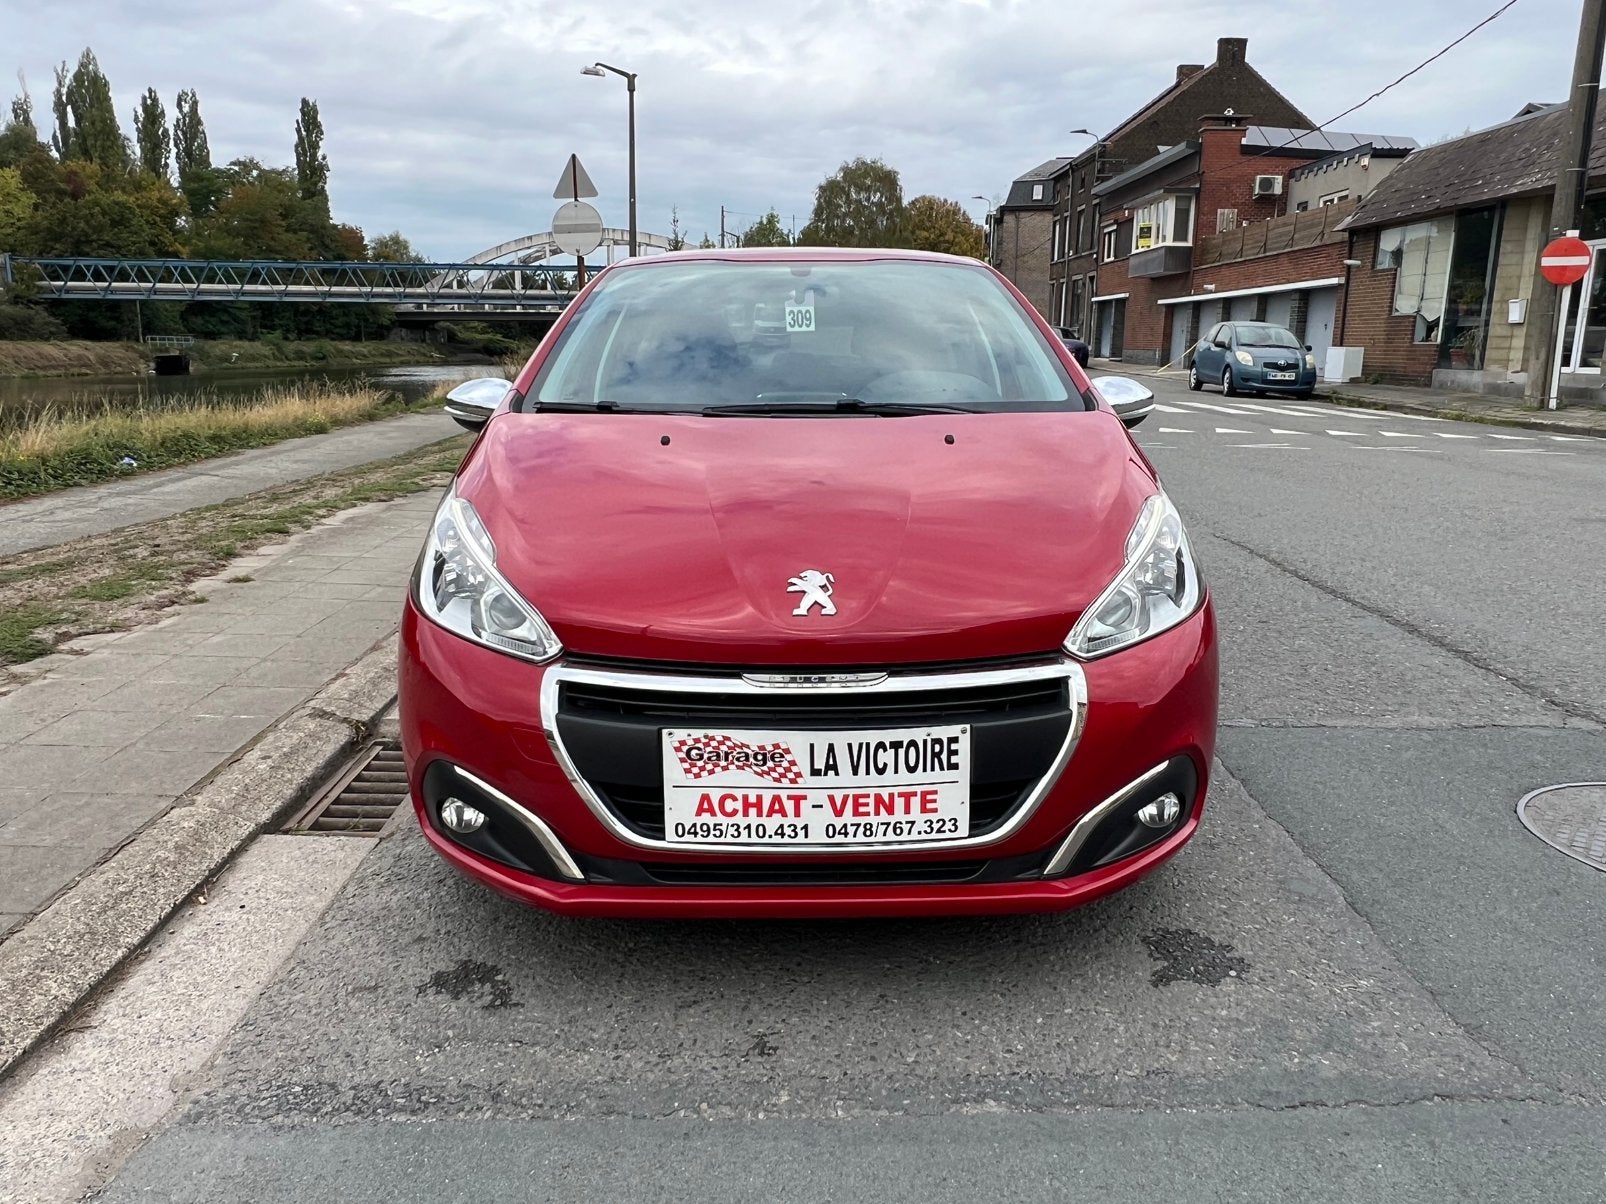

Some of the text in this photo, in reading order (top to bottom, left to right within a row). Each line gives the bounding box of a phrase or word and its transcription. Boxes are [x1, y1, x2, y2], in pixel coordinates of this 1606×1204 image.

[788, 309, 812, 329] 309
[685, 735, 960, 777] Garage LA VICTOIRE
[674, 817, 959, 839] 0495/310.431 0478/767.323
